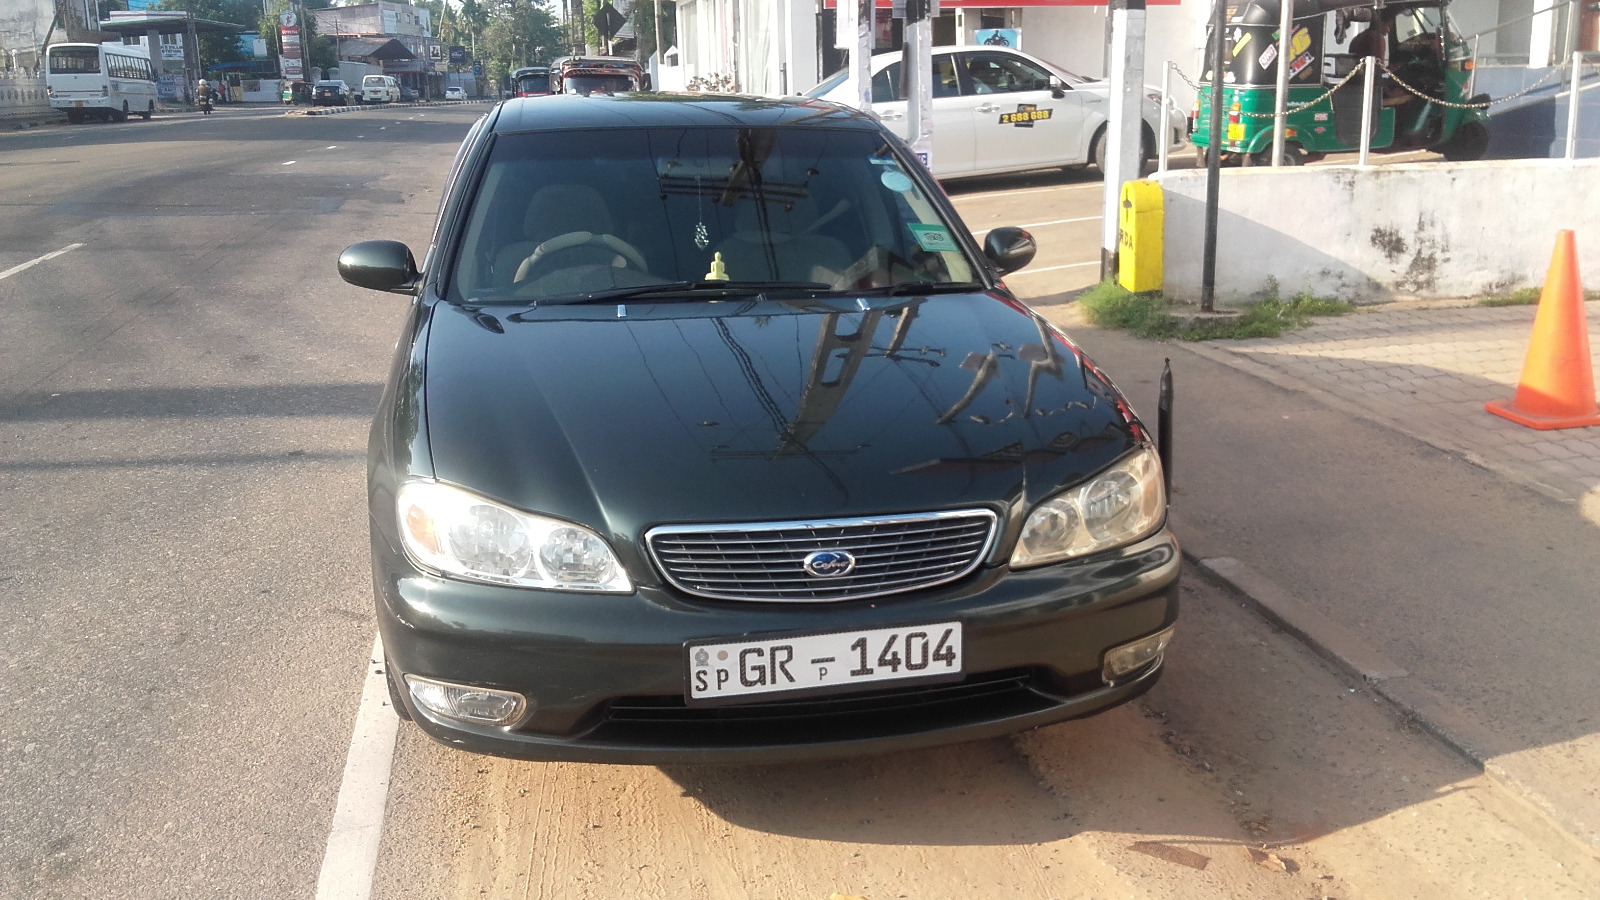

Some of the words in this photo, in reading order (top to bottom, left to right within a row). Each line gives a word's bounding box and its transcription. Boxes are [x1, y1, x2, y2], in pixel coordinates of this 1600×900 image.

[1002, 114, 1009, 123] 2
[1010, 112, 1029, 122] 688
[1030, 110, 1049, 120] 688
[738, 645, 796, 688] GR
[849, 627, 956, 677] 1404
